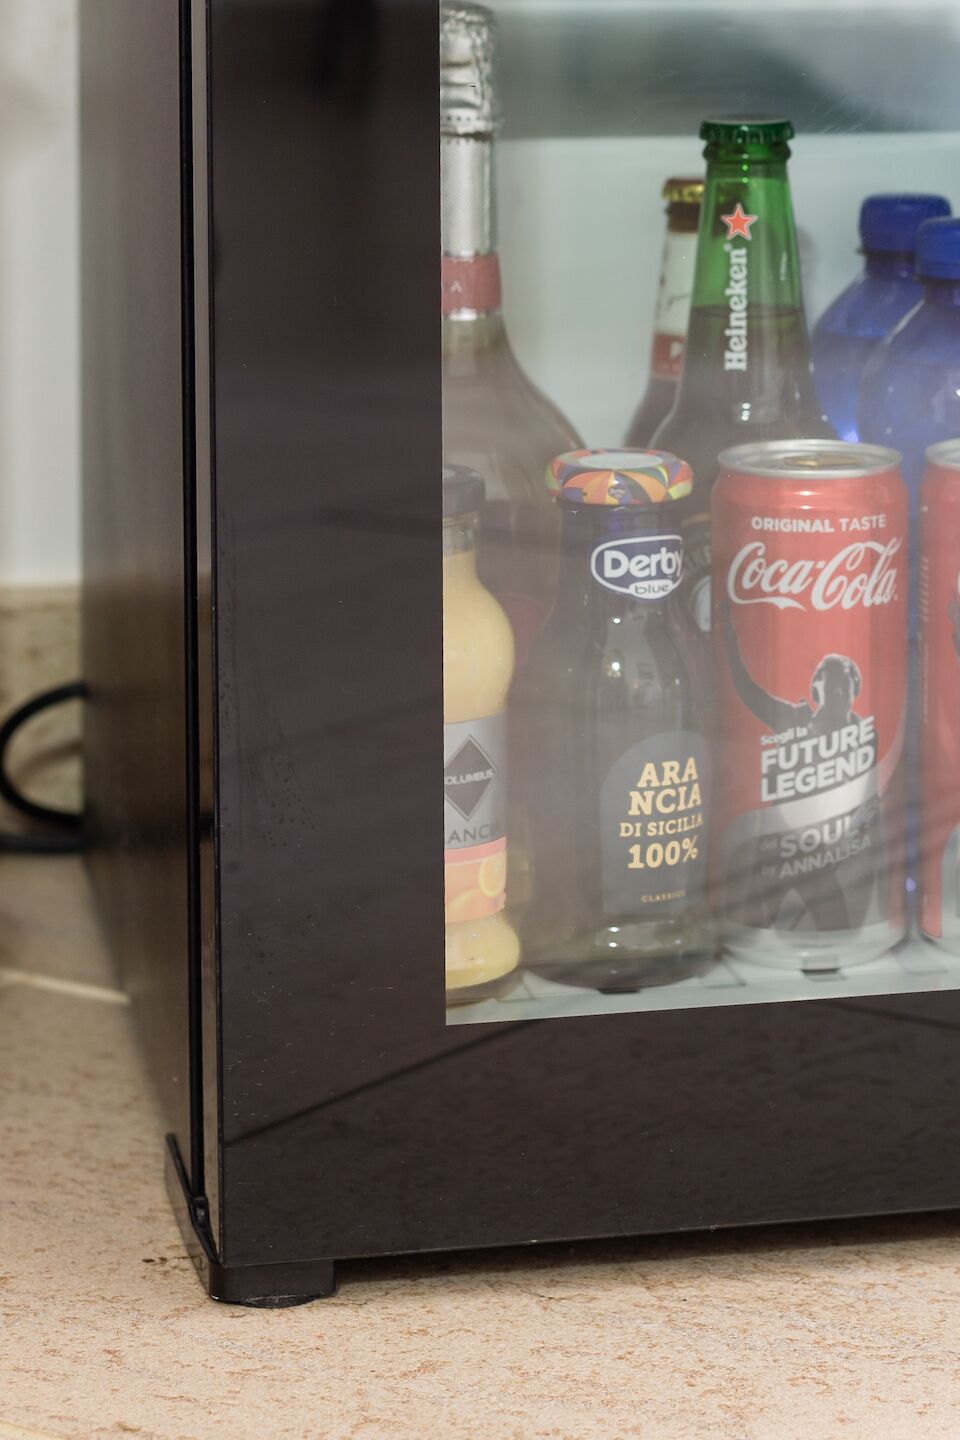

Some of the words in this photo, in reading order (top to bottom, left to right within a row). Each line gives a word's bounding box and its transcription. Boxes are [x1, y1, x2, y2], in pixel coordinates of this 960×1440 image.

[724, 246, 748, 371] Heineken
[751, 516, 835, 533] ORIGINAL
[839, 514, 886, 532] TASTE
[603, 546, 684, 578] Derby
[727, 538, 902, 611] Coca-Cola
[634, 584, 670, 595] blue
[761, 715, 875, 774] FUTURE
[444, 767, 495, 785] OLUMBUS
[637, 757, 698, 788] ARA
[761, 745, 875, 802] LEGEND
[628, 783, 702, 816] NCIA
[619, 822, 642, 837] DI
[646, 812, 704, 837] SICILIA
[627, 835, 698, 869] 100%
